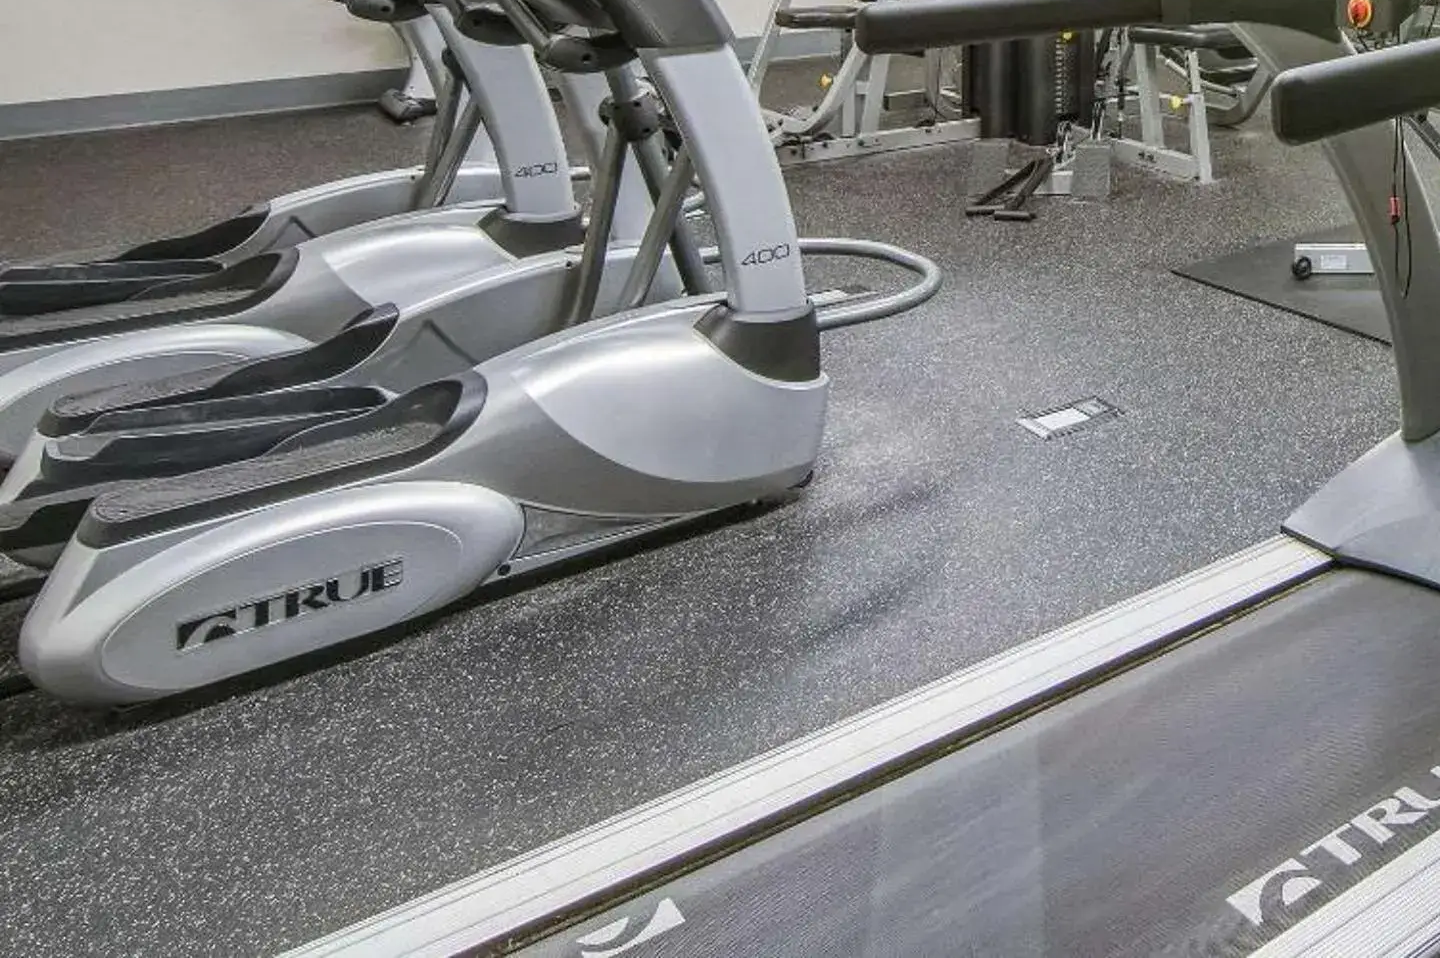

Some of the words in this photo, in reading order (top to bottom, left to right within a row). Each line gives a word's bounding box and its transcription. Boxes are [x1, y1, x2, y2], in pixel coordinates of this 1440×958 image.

[514, 161, 558, 178] 400
[741, 243, 790, 266] 400
[240, 556, 403, 627] TRUE
